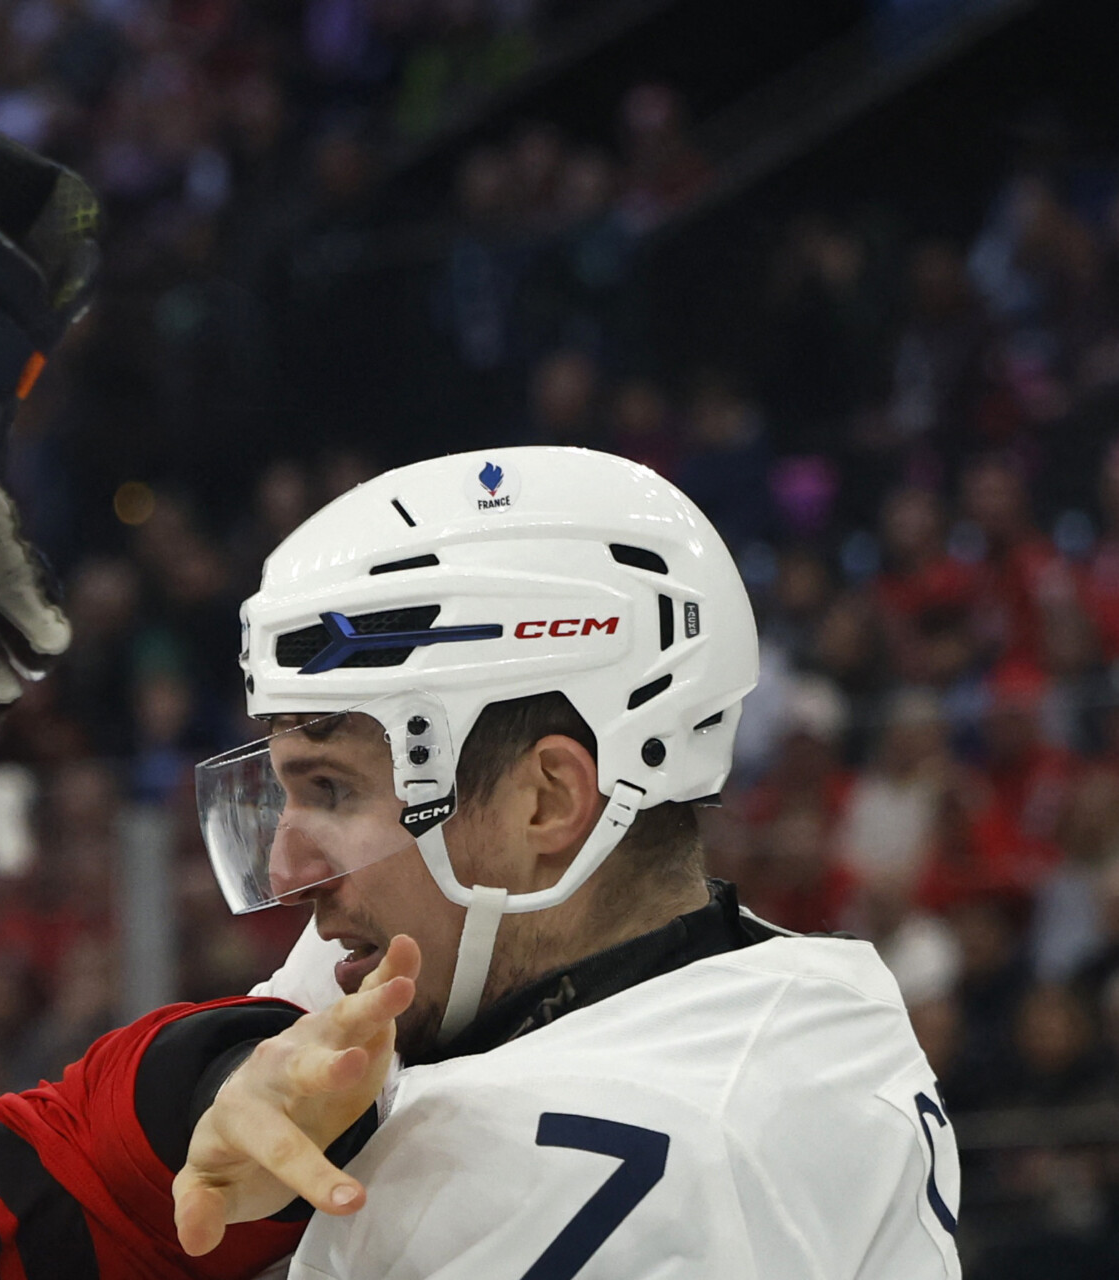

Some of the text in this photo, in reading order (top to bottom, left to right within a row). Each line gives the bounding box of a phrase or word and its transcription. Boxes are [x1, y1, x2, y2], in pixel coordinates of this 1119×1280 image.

[477, 496, 512, 511] FRANCE
[514, 617, 620, 639] CCM
[404, 804, 450, 824] CCM
